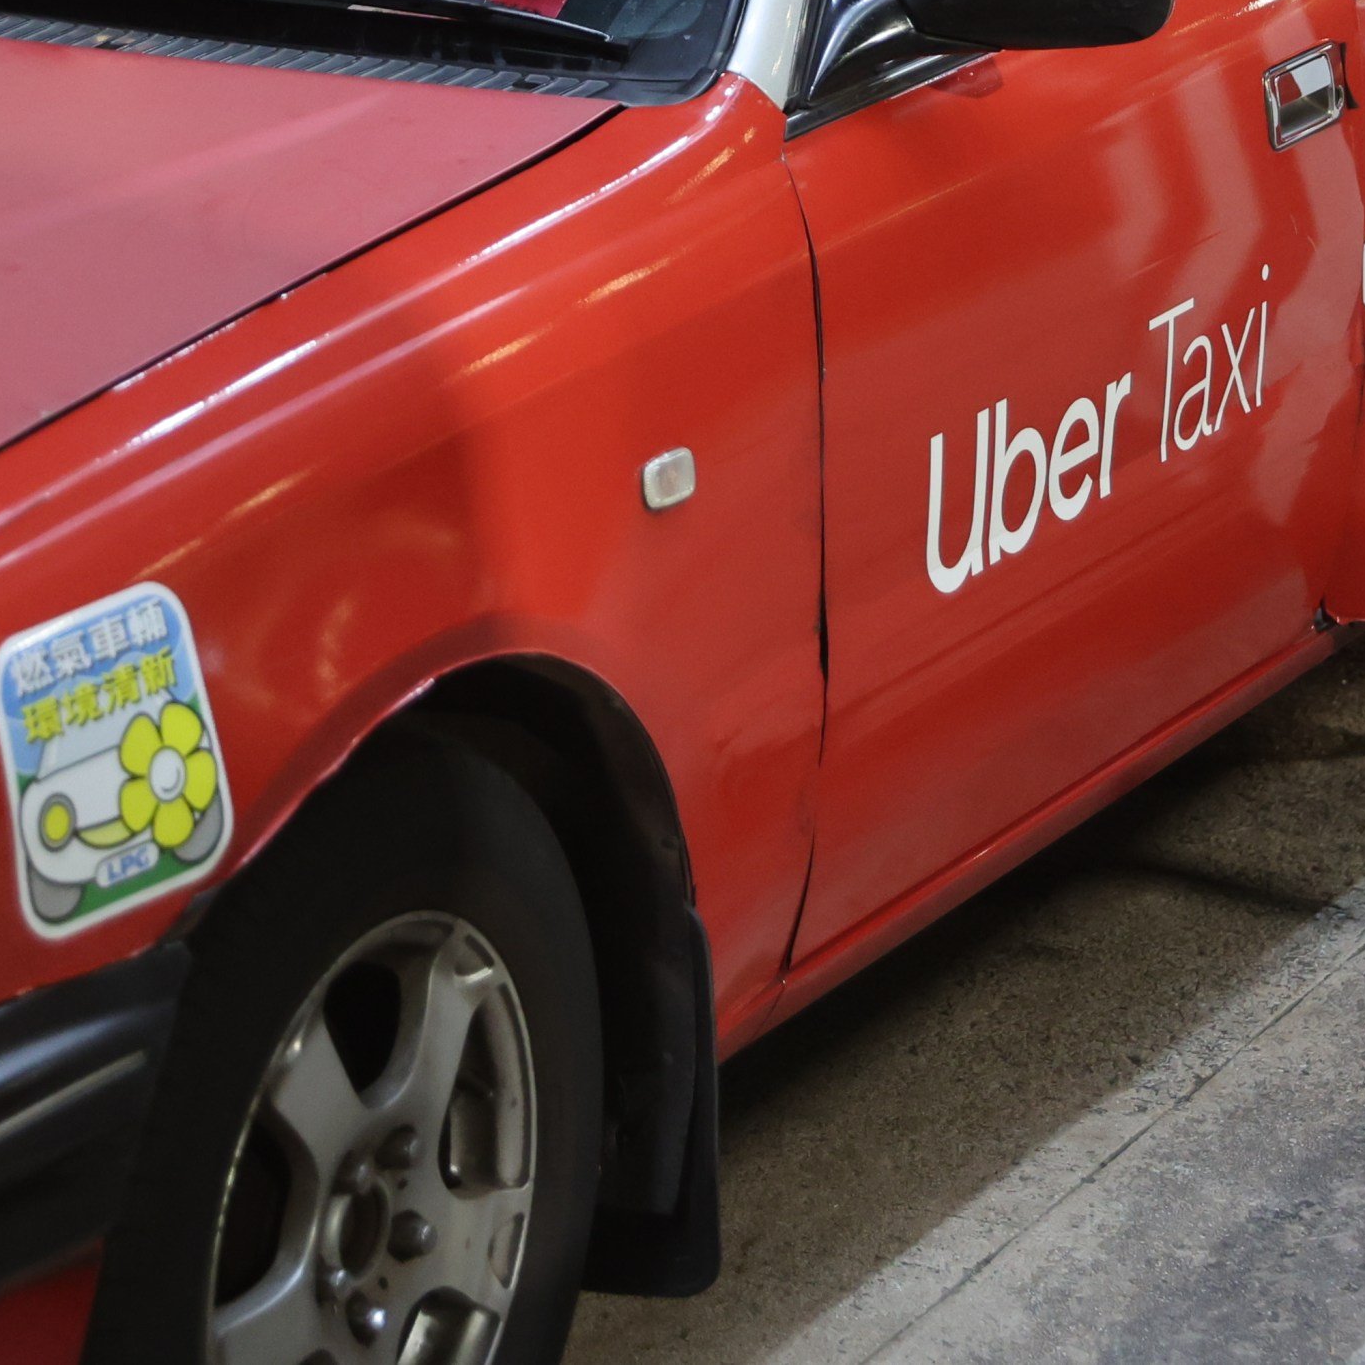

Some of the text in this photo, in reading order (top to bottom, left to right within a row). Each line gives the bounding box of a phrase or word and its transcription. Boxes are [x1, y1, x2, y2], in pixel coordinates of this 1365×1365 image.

[926, 263, 1270, 594] Uber Taxi
[22, 645, 178, 745] 環境清新
[107, 845, 150, 884] LPG
